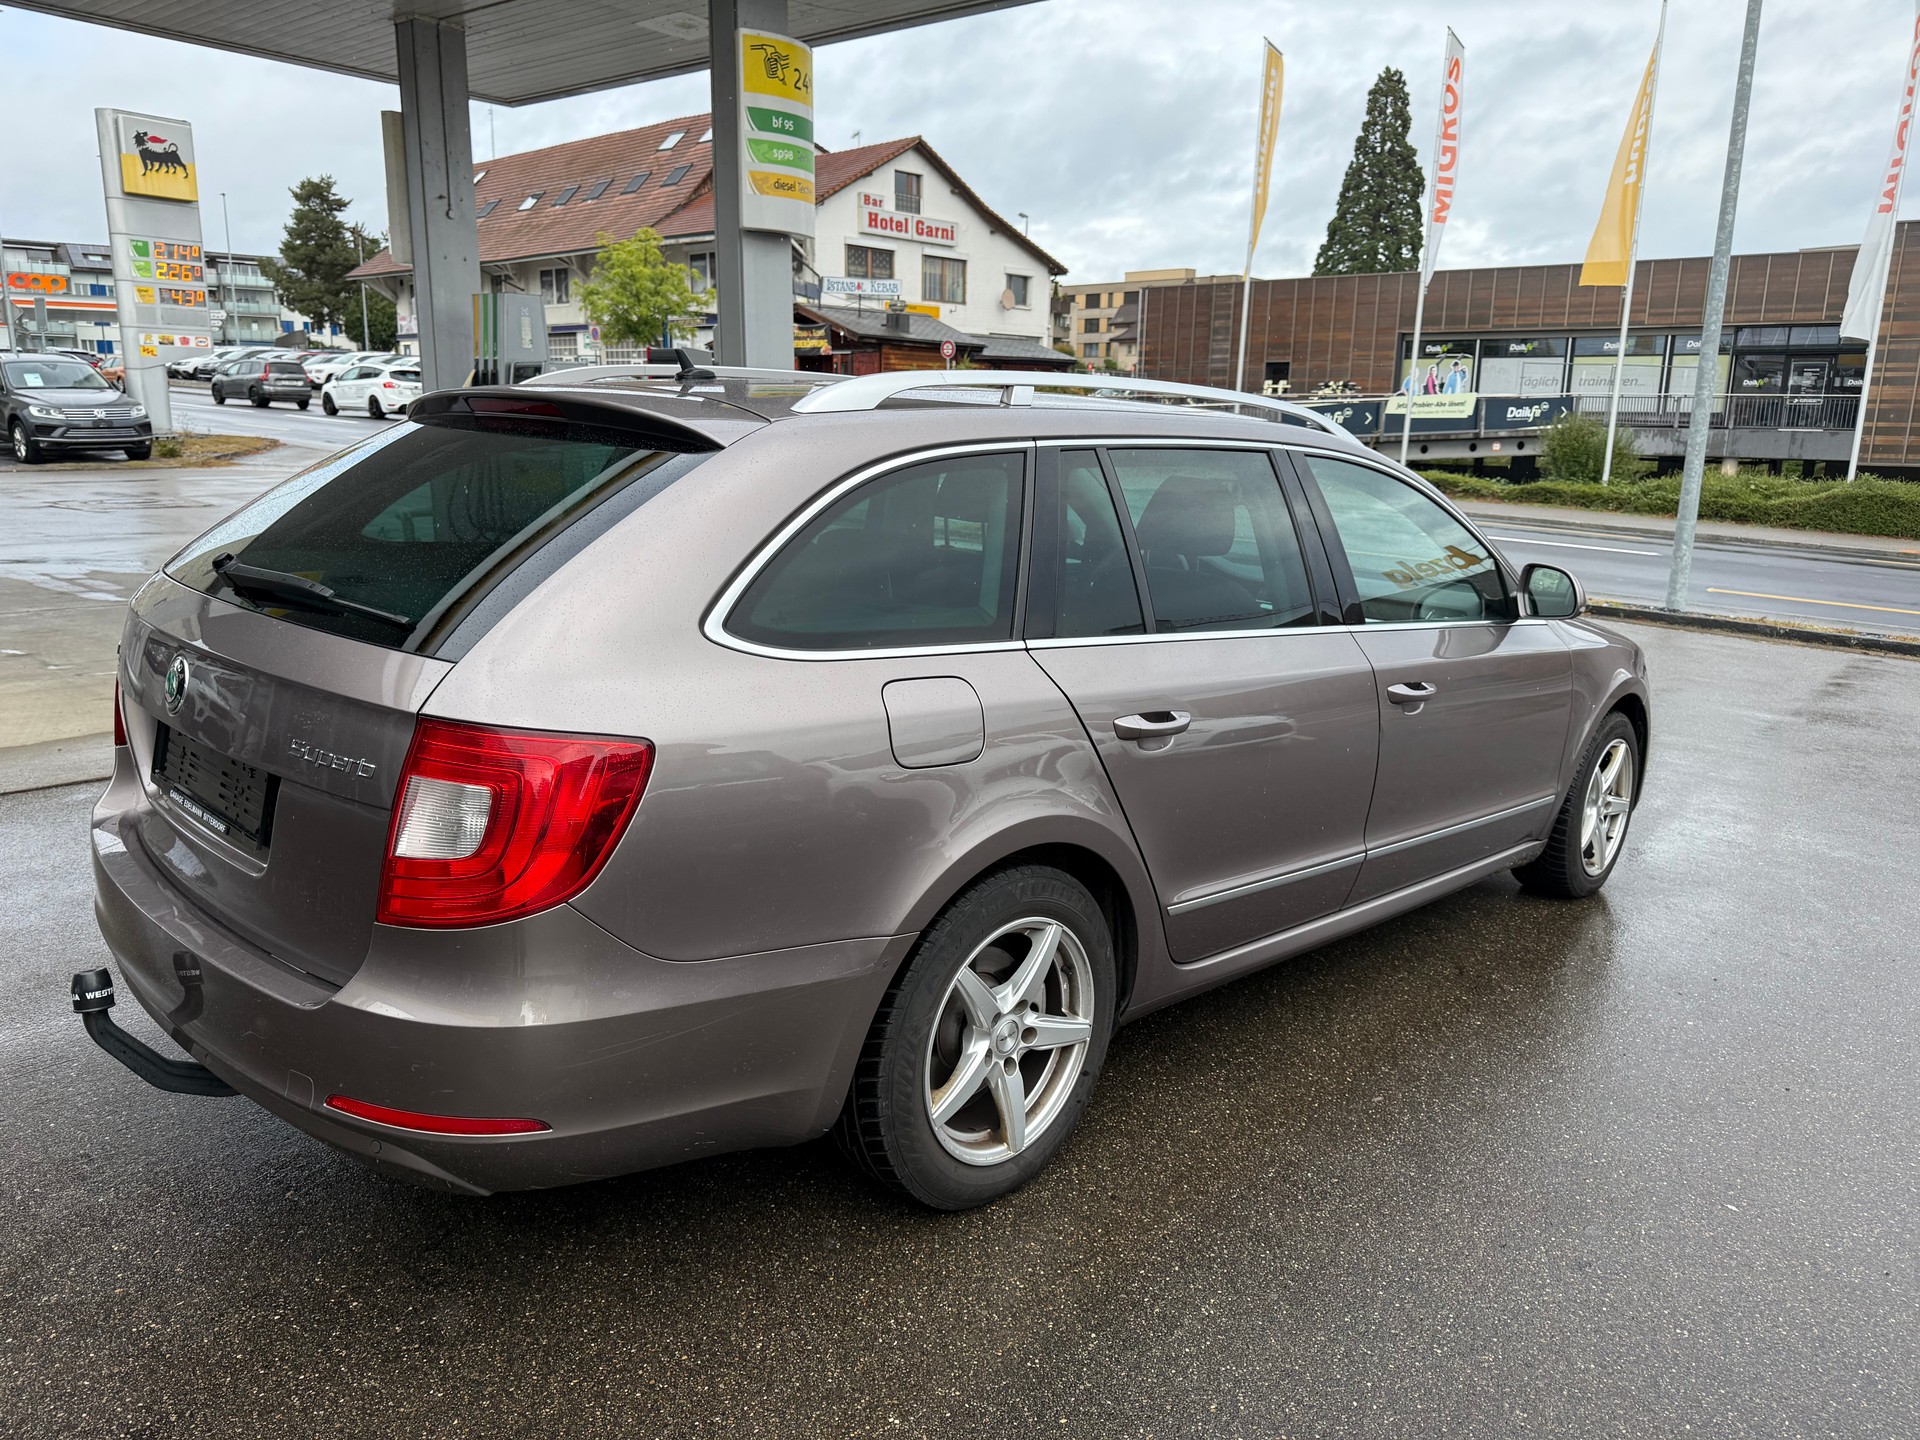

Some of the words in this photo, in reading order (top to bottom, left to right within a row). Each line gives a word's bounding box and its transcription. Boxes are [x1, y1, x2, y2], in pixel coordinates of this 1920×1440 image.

[772, 116, 783, 129] bf
[784, 119, 794, 131] 95
[1432, 55, 1461, 224] MIGROS
[772, 148, 794, 161] sp98
[773, 178, 797, 193] diesel
[863, 194, 884, 208] Bar
[868, 211, 909, 234] Hotel
[915, 219, 955, 241] Garni
[7, 272, 67, 295] oop
[870, 281, 899, 293] KEBAB
[1520, 376, 1560, 390] Täglich
[288, 738, 376, 780] Superb
